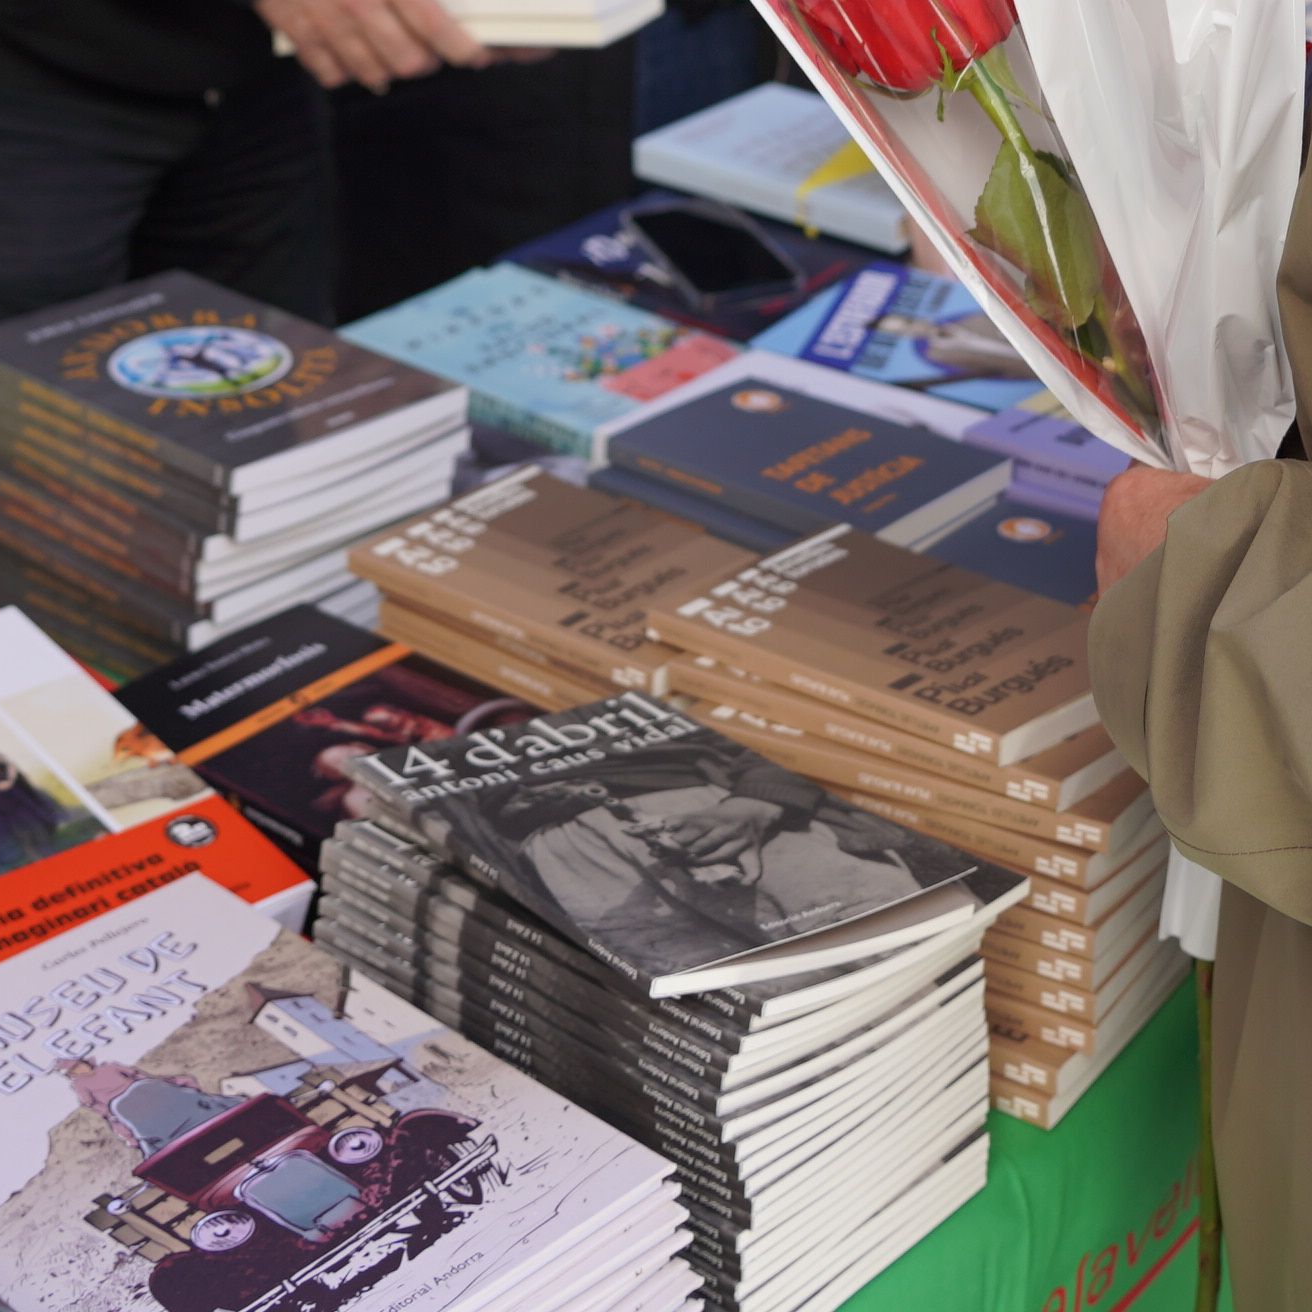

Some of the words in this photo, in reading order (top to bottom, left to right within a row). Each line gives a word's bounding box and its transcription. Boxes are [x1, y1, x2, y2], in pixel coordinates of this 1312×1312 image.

[914, 670, 989, 705] Pilar
[947, 653, 1075, 716] Burgués
[354, 745, 455, 787] 14
[465, 691, 681, 769] d'abril
[400, 764, 521, 803] antoni
[529, 747, 607, 776] caus
[612, 710, 701, 754] vidal
[31, 851, 165, 913] definitiva
[119, 931, 200, 974] DE
[432, 1250, 485, 1287] Andorra
